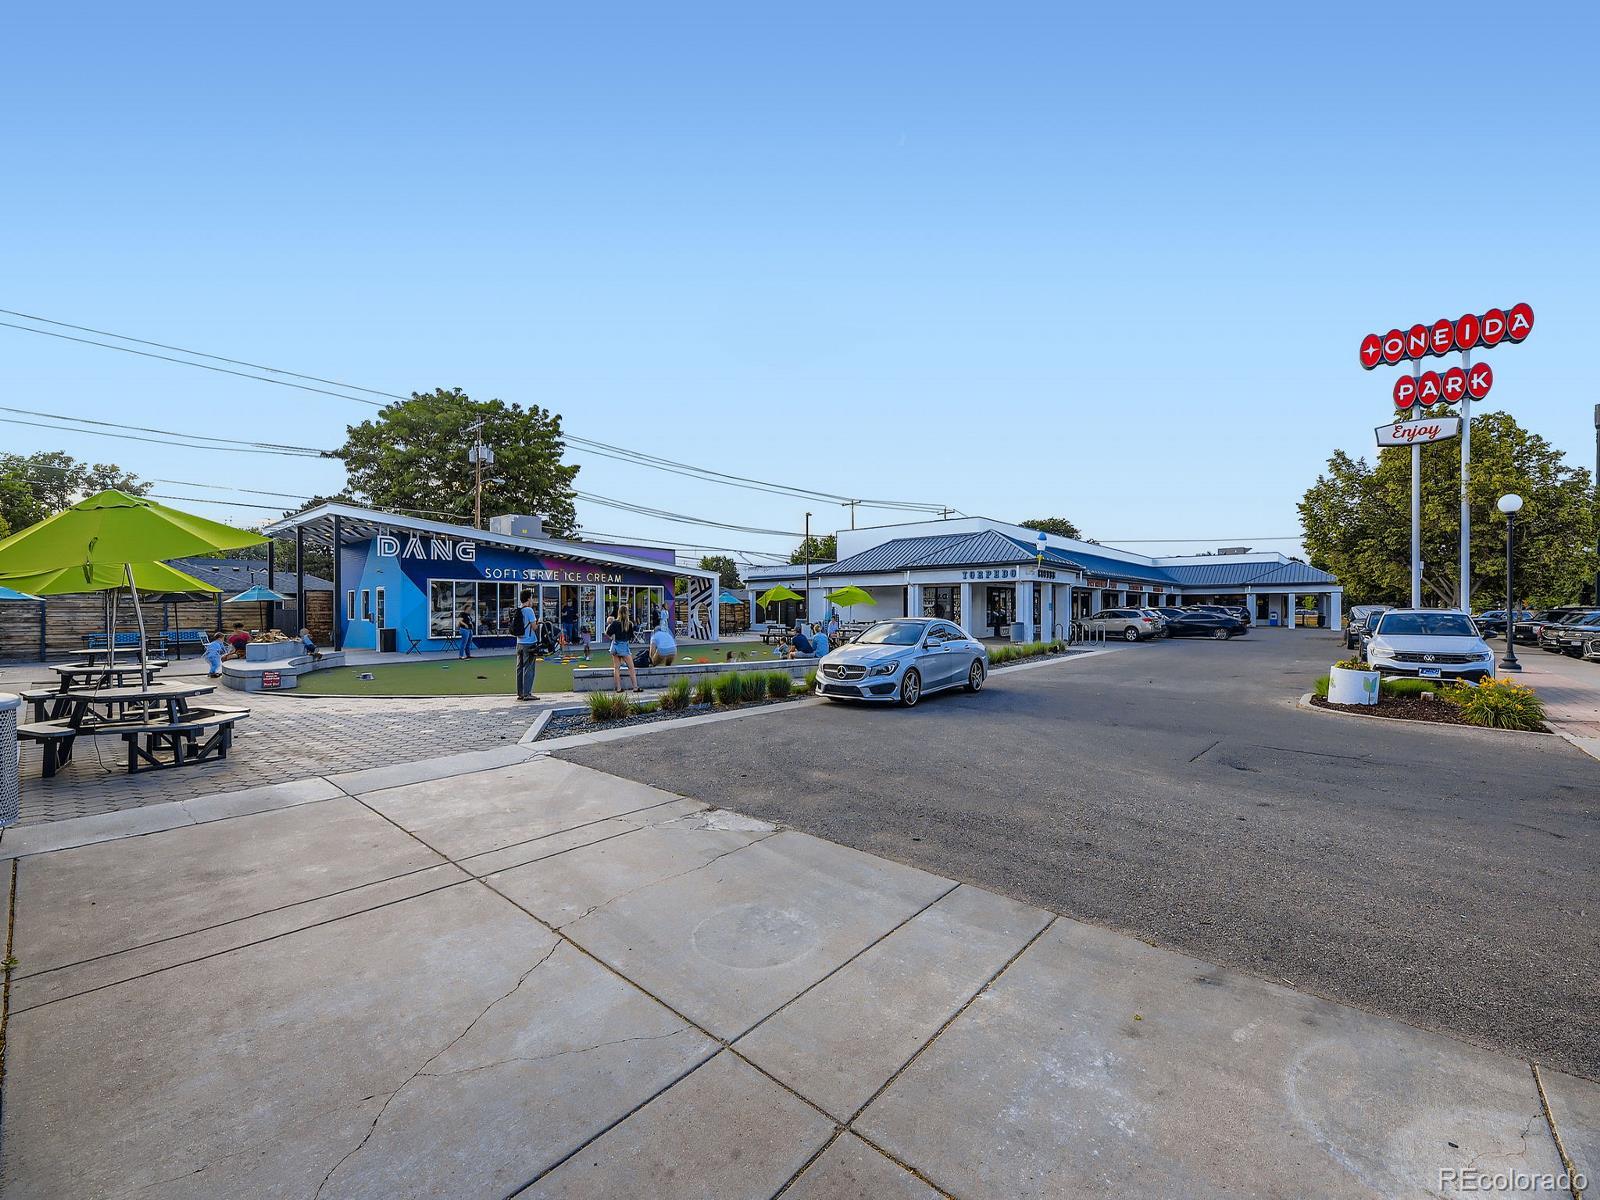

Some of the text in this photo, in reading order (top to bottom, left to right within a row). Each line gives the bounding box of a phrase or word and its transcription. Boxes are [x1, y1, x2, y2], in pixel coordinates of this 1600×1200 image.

[1384, 313, 1530, 355] ONEIDA
[1398, 371, 1489, 400] PARK
[1392, 425, 1441, 442] Enjoy
[376, 535, 476, 562] DANG
[484, 568, 622, 583] SOFT SERVE ICE CREAM
[961, 568, 1017, 580] TORPEDO
